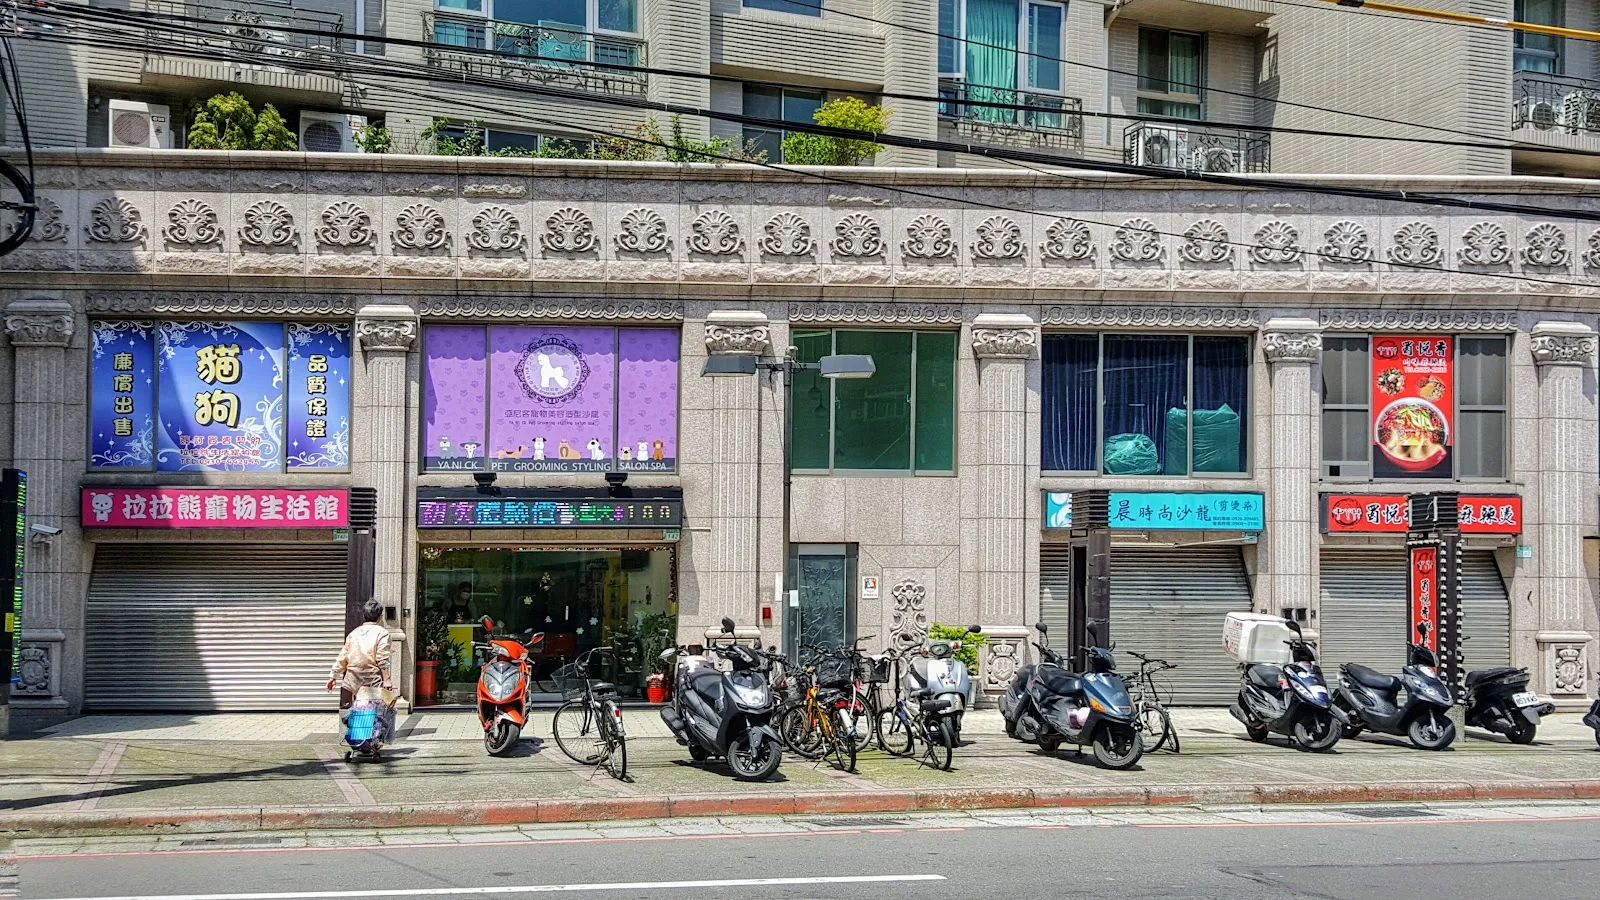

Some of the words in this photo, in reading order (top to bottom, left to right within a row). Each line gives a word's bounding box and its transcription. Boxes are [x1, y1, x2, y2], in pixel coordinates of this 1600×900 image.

[113, 352, 133, 436] 廉價出售
[306, 354, 328, 438] 品質保證
[491, 462, 509, 471] PET
[513, 462, 568, 472] GROOMING
[572, 462, 611, 472] STYLING
[619, 462, 649, 471] SALON
[651, 462, 667, 471] SPA
[122, 494, 340, 521] 拉拉熊寵物生活館
